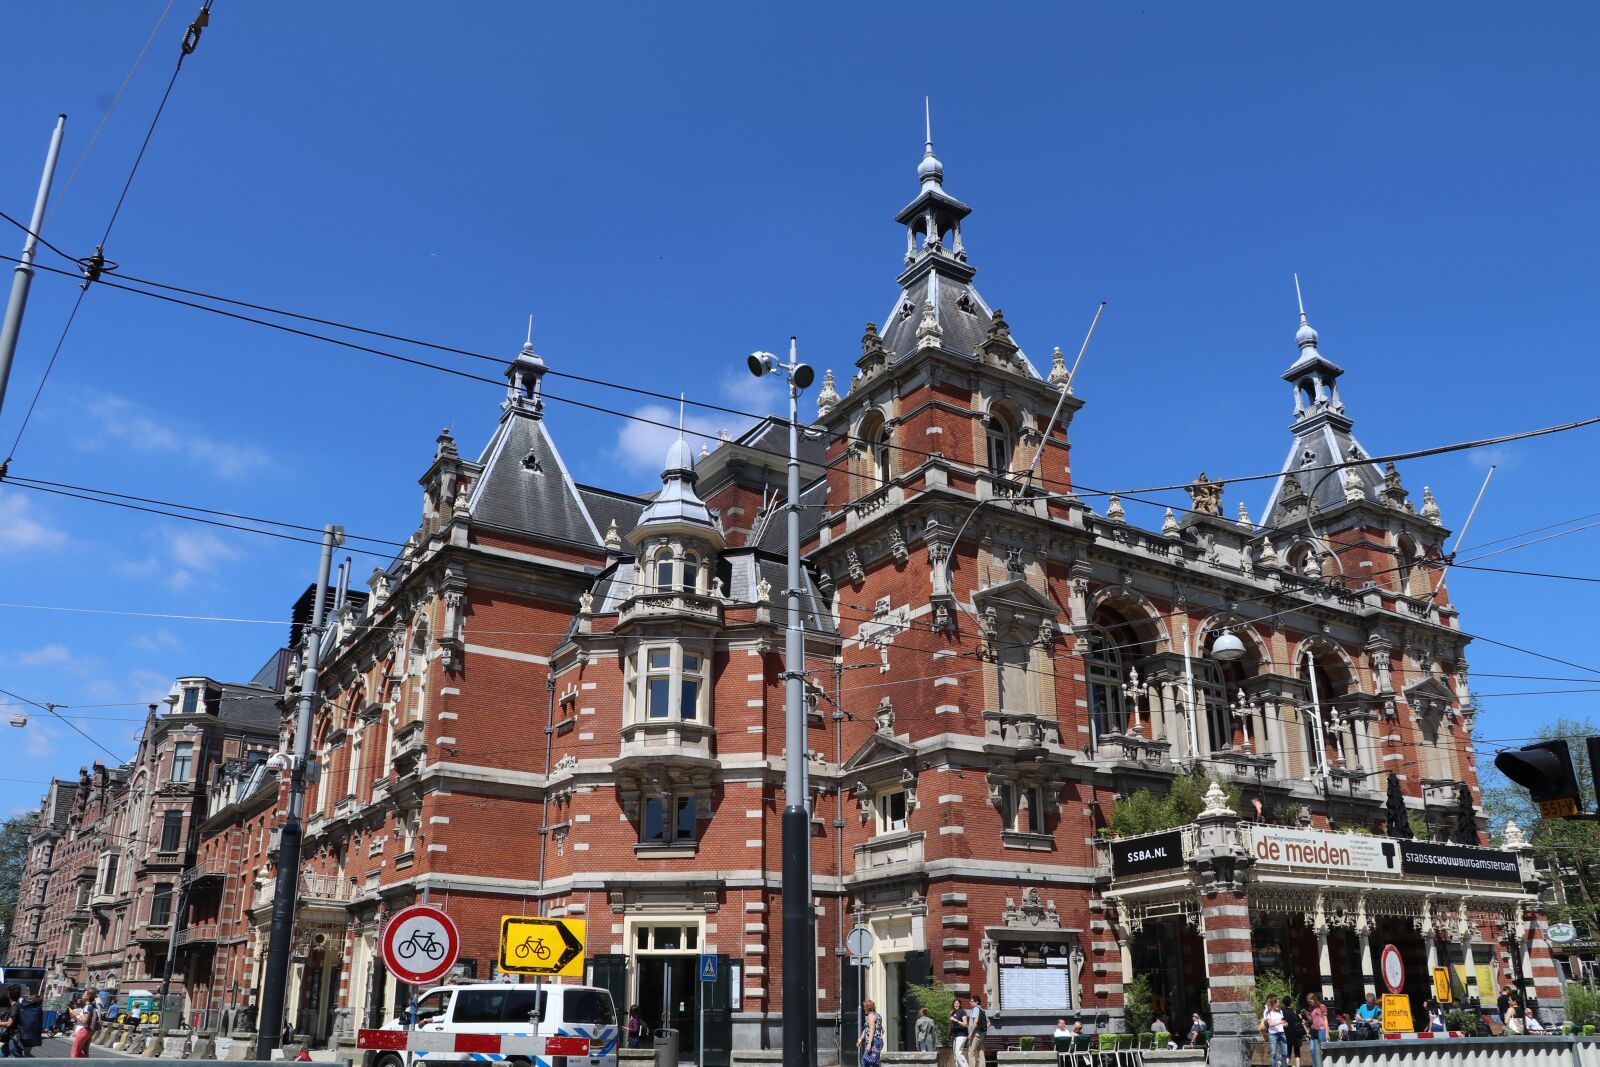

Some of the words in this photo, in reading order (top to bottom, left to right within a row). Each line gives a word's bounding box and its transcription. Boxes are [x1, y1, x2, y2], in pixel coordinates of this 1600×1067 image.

[1127, 846, 1168, 863] SSBA.NL
[1256, 835, 1280, 861] de
[1285, 840, 1351, 866] meiden
